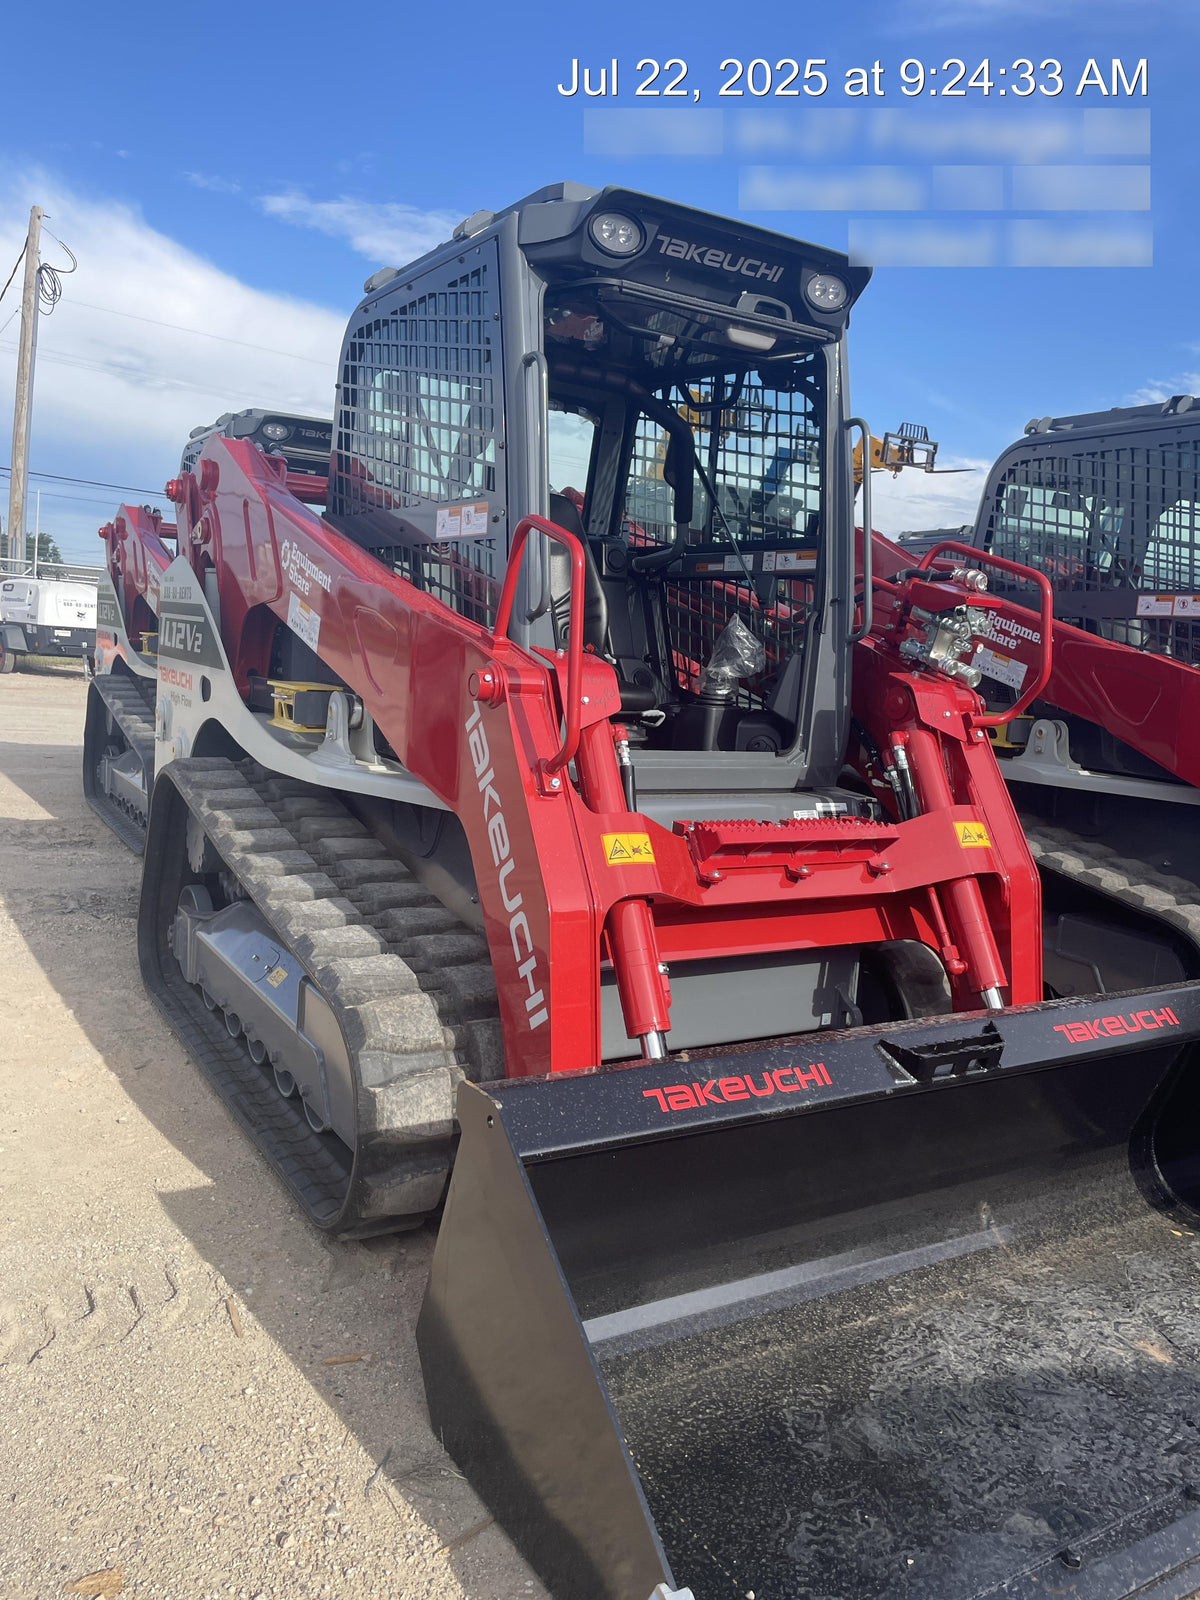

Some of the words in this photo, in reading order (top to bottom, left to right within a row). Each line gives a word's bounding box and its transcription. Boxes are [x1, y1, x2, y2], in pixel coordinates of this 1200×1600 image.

[656, 234, 785, 283] TAKEUCHI
[289, 562, 310, 596] Share
[291, 541, 332, 593] Equipment
[987, 609, 1055, 645] Equipme
[159, 665, 193, 691] TAKEUCHI
[465, 699, 549, 1030] TAKEUCHI
[1054, 1007, 1179, 1043] TAKEUCHI
[643, 1062, 833, 1112] TAKEUCHI
